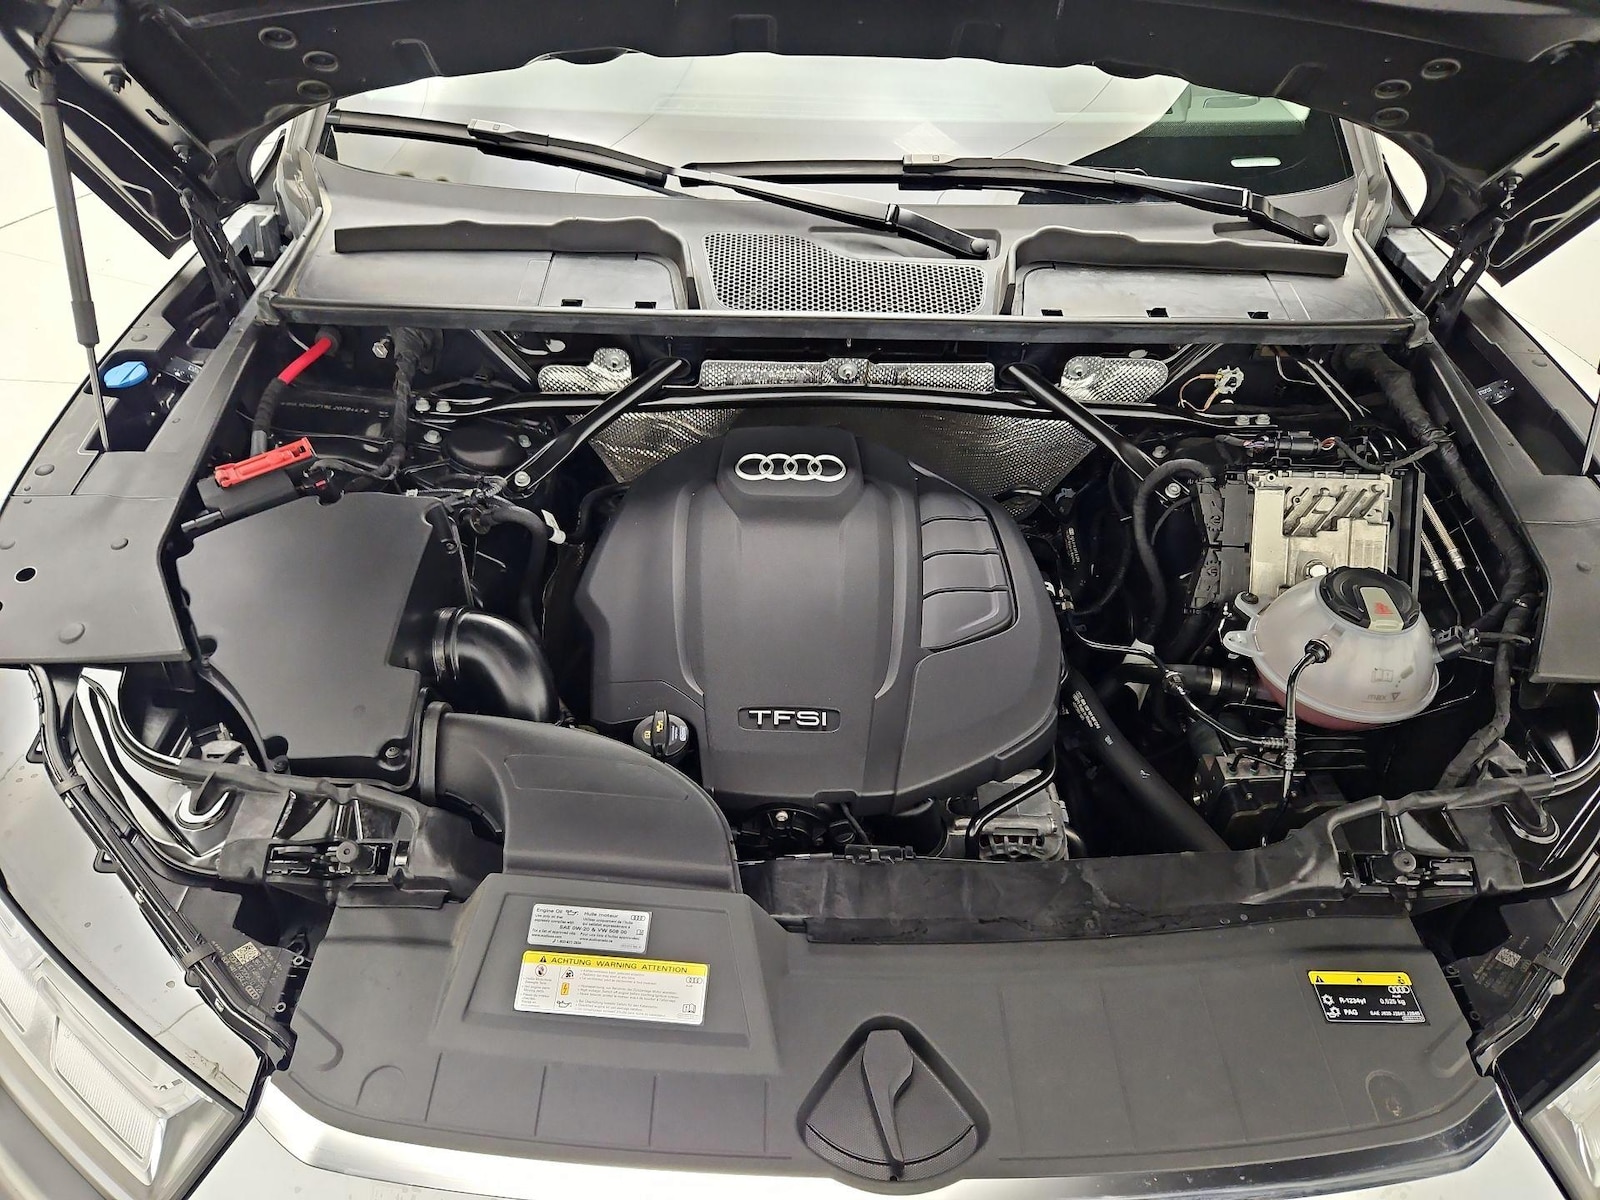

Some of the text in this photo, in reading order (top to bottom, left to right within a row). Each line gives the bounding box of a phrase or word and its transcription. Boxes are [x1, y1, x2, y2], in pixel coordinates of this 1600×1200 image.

[748, 710, 826, 726] TFSI
[551, 957, 688, 973] ACHTUNG WARNING ATTENTION
